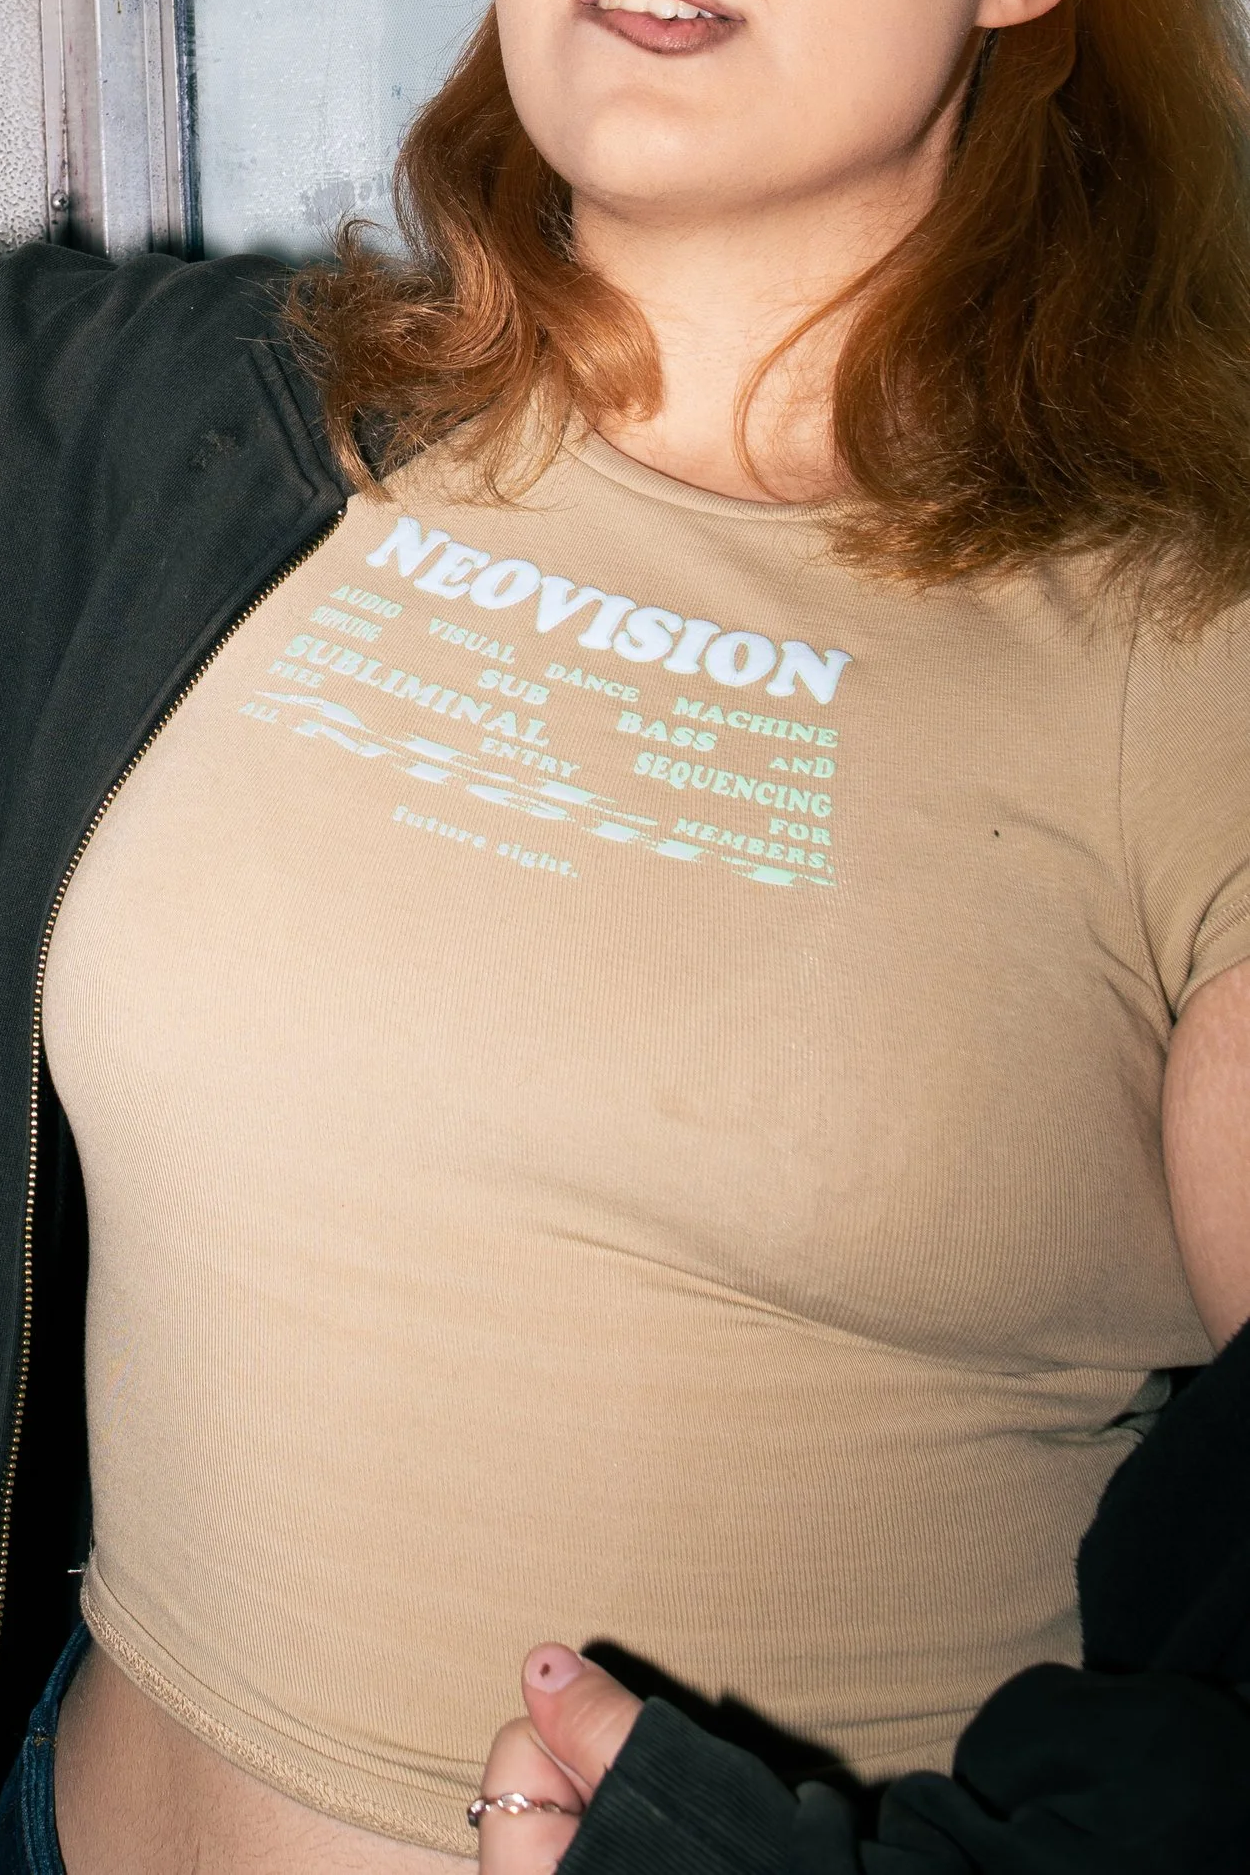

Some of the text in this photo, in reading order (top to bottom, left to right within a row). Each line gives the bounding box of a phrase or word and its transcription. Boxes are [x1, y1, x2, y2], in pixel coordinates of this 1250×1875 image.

[329, 584, 839, 748] AUDIO VISUAL DANCE MACHINE
[365, 515, 853, 705] NEOVISION
[238, 701, 836, 875] ALL MEMBERS,
[267, 658, 833, 846] FREE ENTRY FOR
[284, 633, 833, 818] SUBLIMINAL SEQUENCING
[477, 668, 550, 705] SUB
[616, 709, 718, 752] BASS
[768, 755, 836, 779] AND
[391, 804, 579, 878] future sight.
